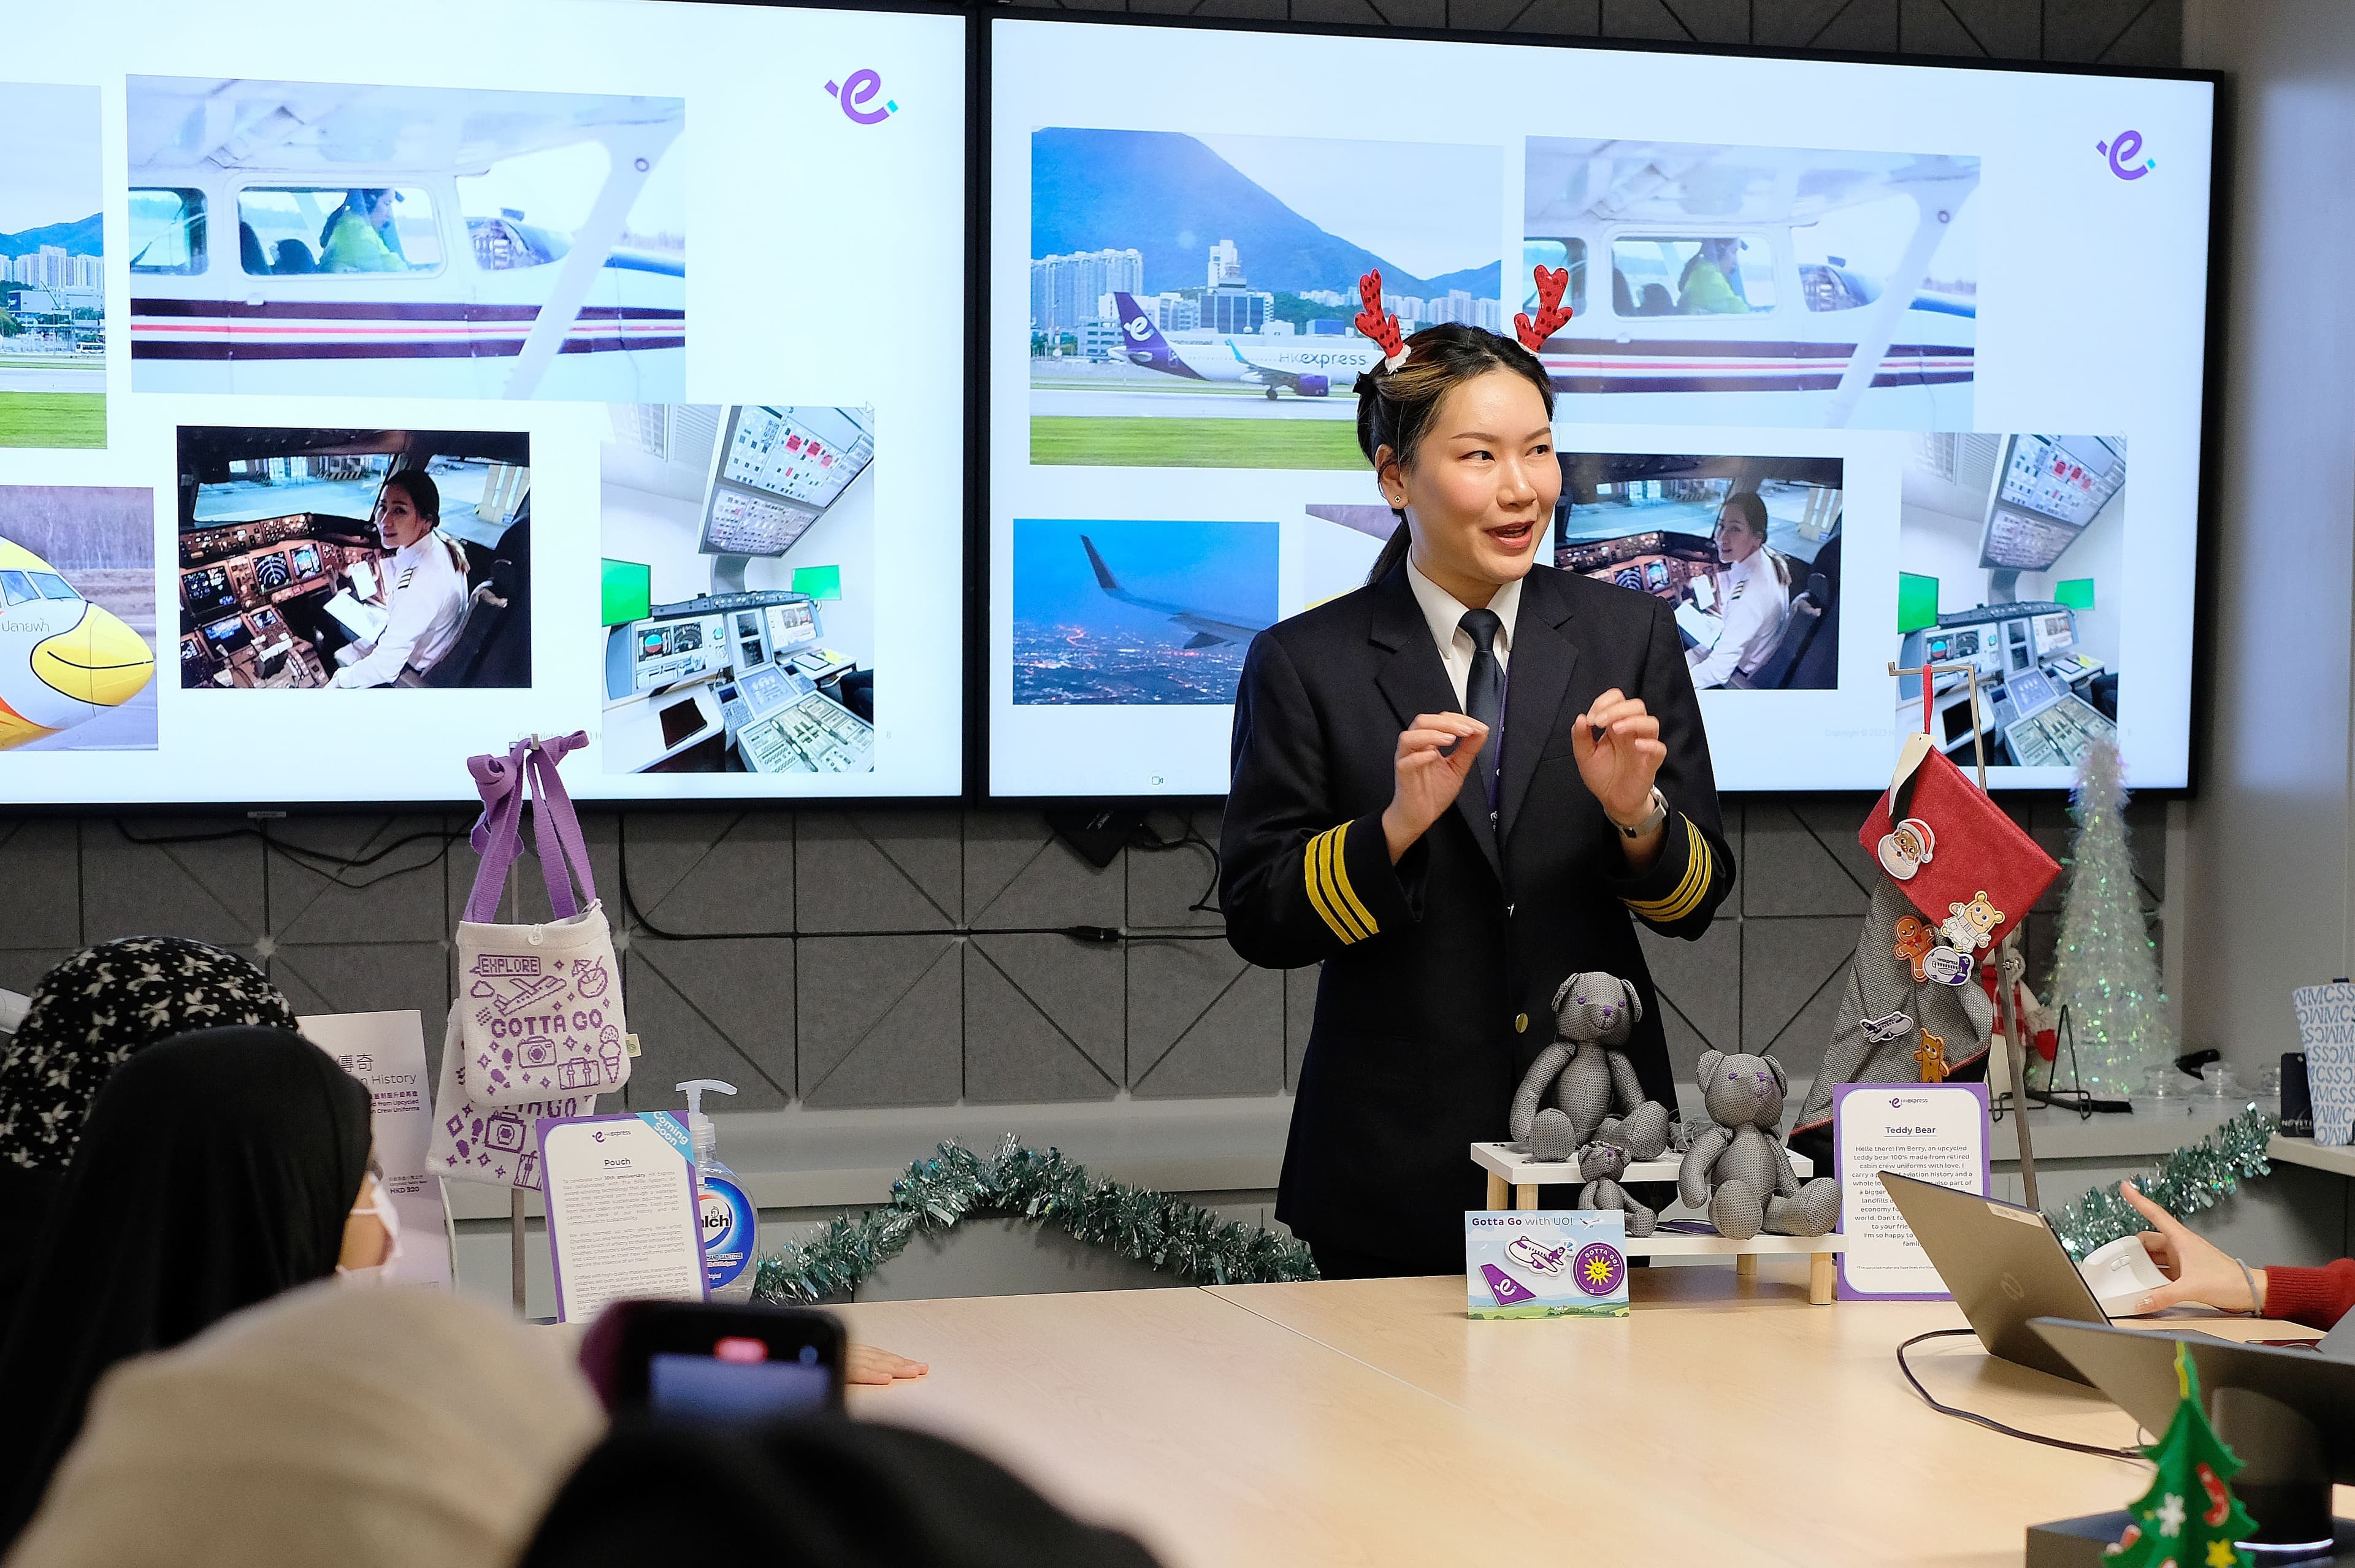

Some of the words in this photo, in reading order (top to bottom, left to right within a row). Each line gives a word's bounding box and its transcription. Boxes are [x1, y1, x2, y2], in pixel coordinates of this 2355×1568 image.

[1280, 353, 1366, 368] HKexpress
[481, 957, 538, 973] EXPLORE
[491, 1014, 566, 1038] GOTTA
[572, 1009, 602, 1031] GO
[372, 1074, 416, 1085] History
[653, 1111, 689, 1145] Coming
[654, 1122, 678, 1145] Soon
[1885, 1126, 1913, 1135] Teddy
[1472, 1217, 1503, 1226] Gotta
[1507, 1217, 1522, 1226] Go
[1525, 1217, 1550, 1226] with
[1585, 1249, 1607, 1258] GOTTA
